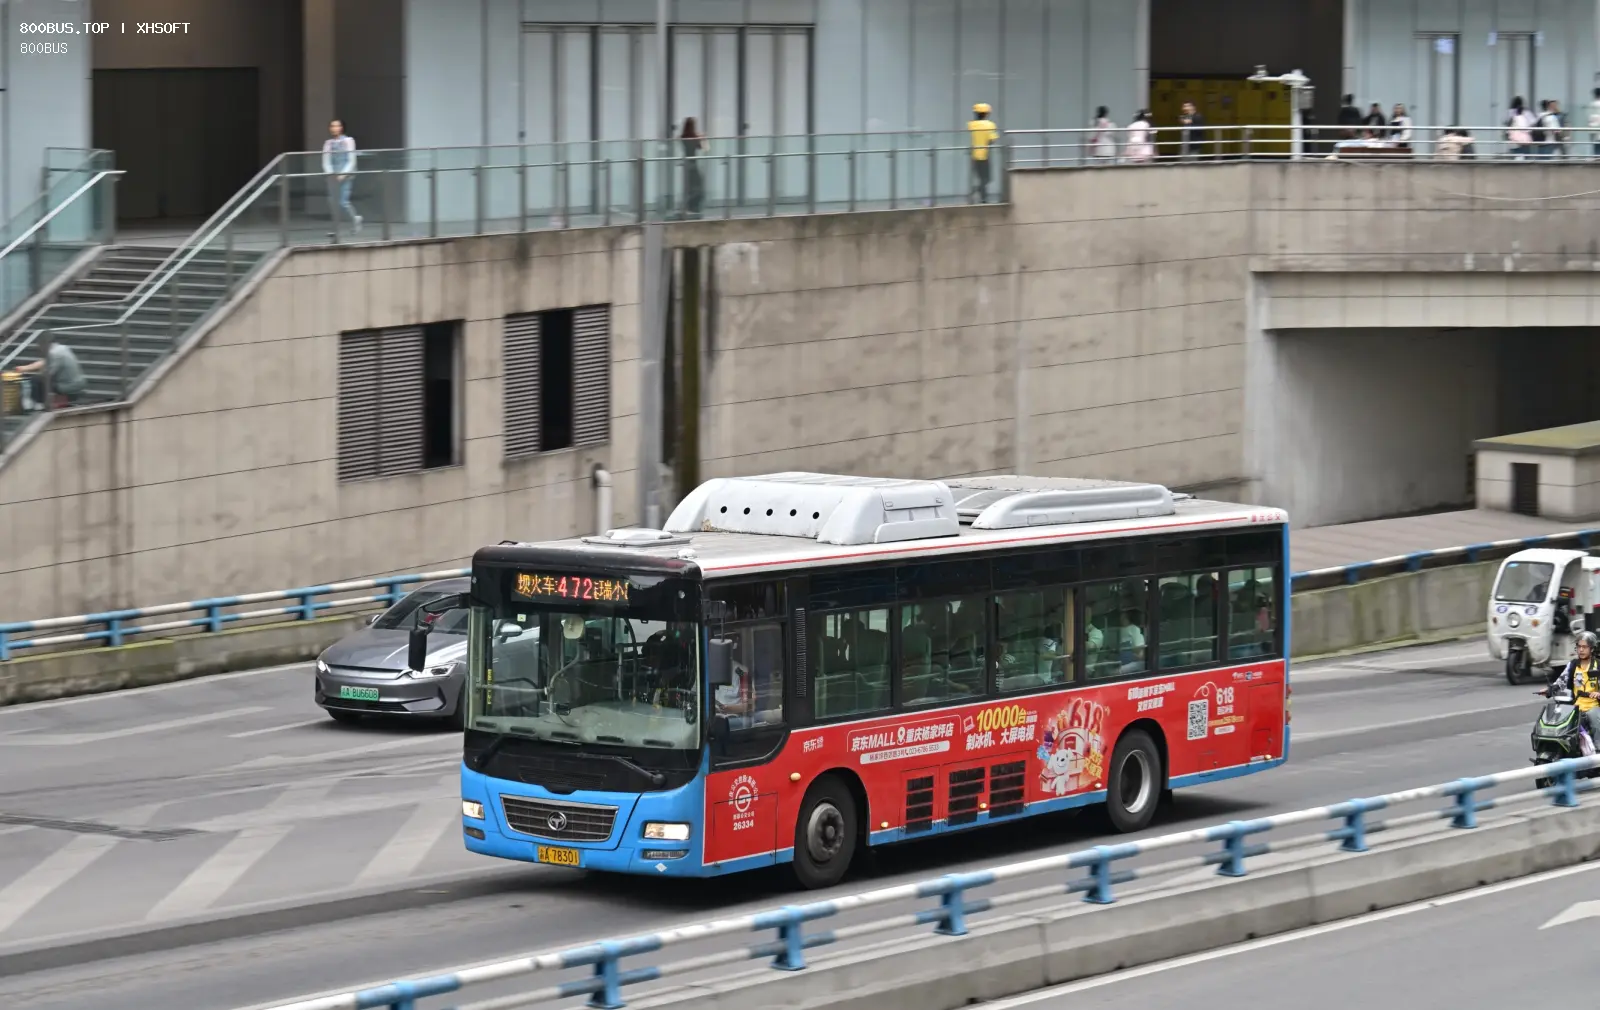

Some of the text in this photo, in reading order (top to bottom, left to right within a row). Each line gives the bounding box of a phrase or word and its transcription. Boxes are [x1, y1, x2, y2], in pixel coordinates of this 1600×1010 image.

[558, 576, 593, 599] 472
[1216, 687, 1234, 705] 618
[851, 733, 896, 752] 京东MALL
[733, 820, 754, 831] 26334
